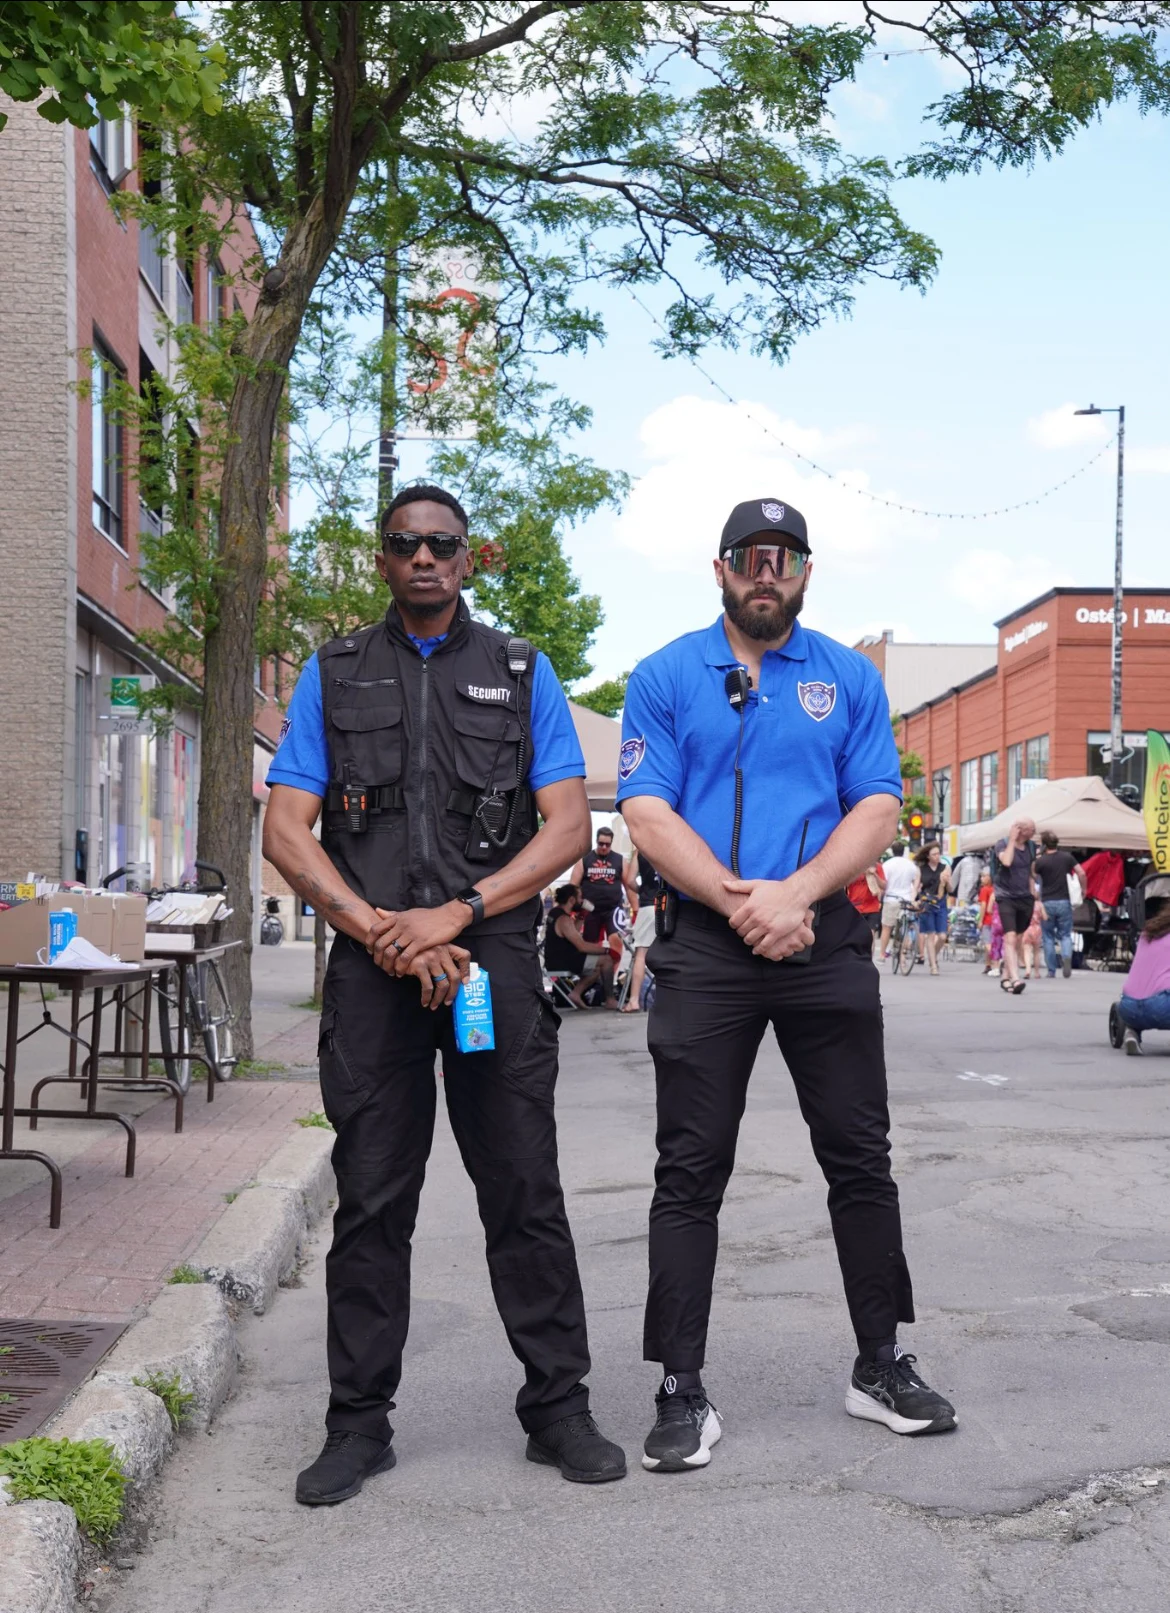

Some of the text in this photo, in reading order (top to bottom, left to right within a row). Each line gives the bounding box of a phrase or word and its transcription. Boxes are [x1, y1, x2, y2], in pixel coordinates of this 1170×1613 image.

[468, 685, 511, 702] SECURITY
[113, 721, 139, 732] 2695
[1154, 781, 1169, 870] onteiro
[464, 982, 486, 993] BIO
